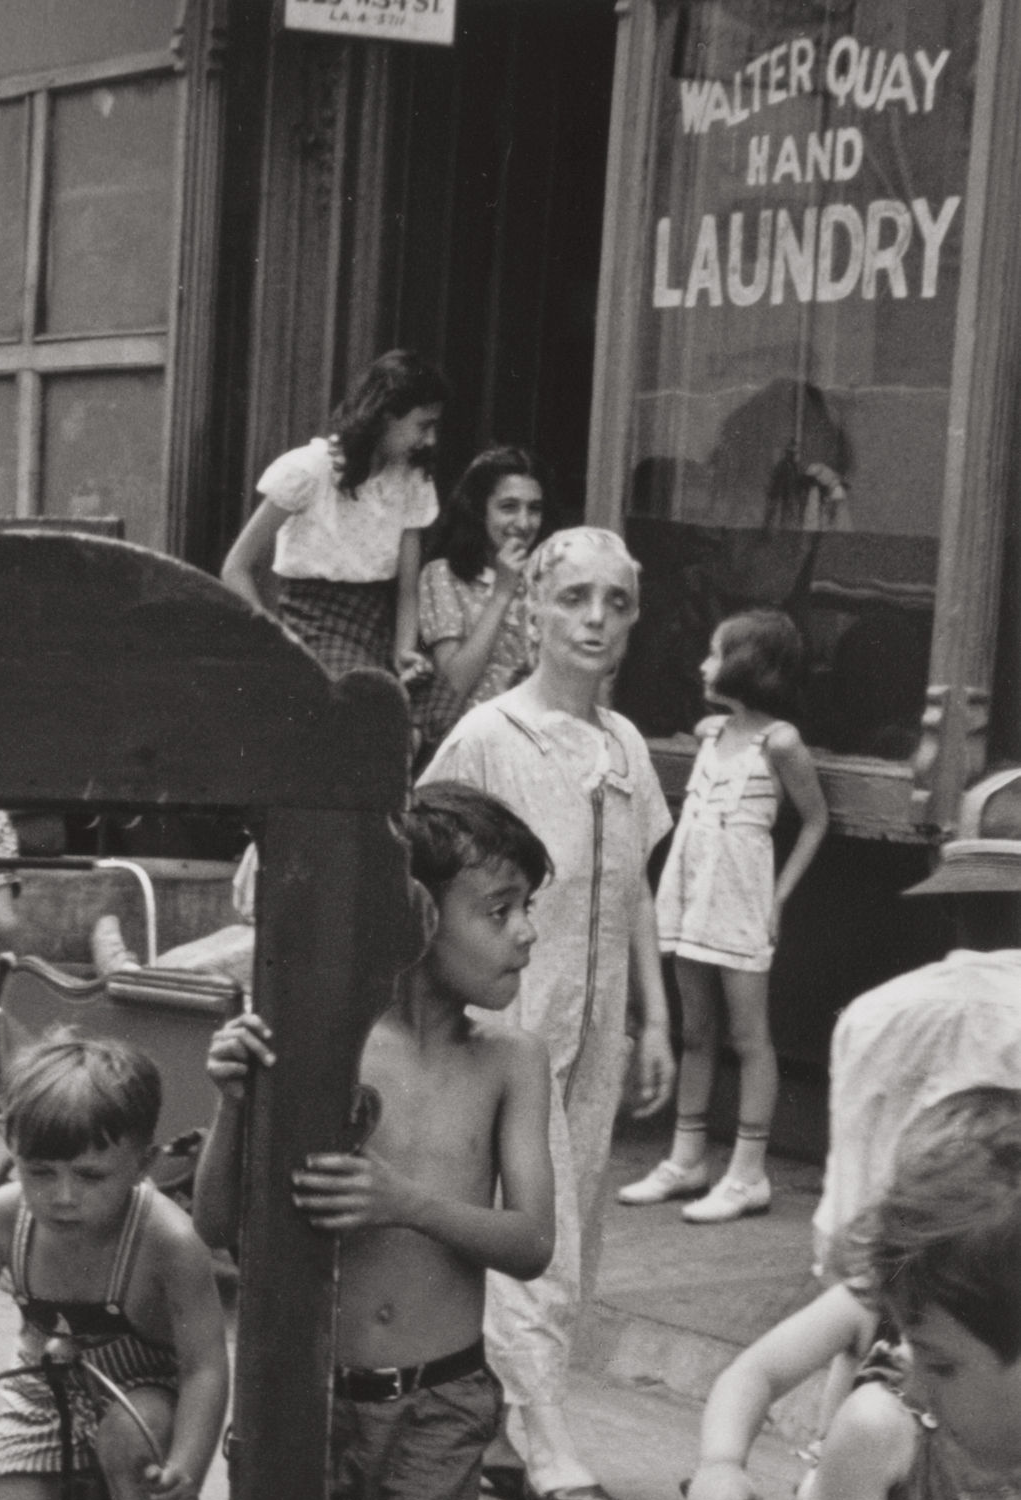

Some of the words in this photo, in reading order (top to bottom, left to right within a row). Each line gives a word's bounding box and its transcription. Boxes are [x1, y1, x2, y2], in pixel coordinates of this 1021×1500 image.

[681, 38, 816, 134] WALTER
[827, 36, 951, 114] QUAY
[746, 126, 864, 187] HAND
[653, 195, 961, 308] LAUNDRY
